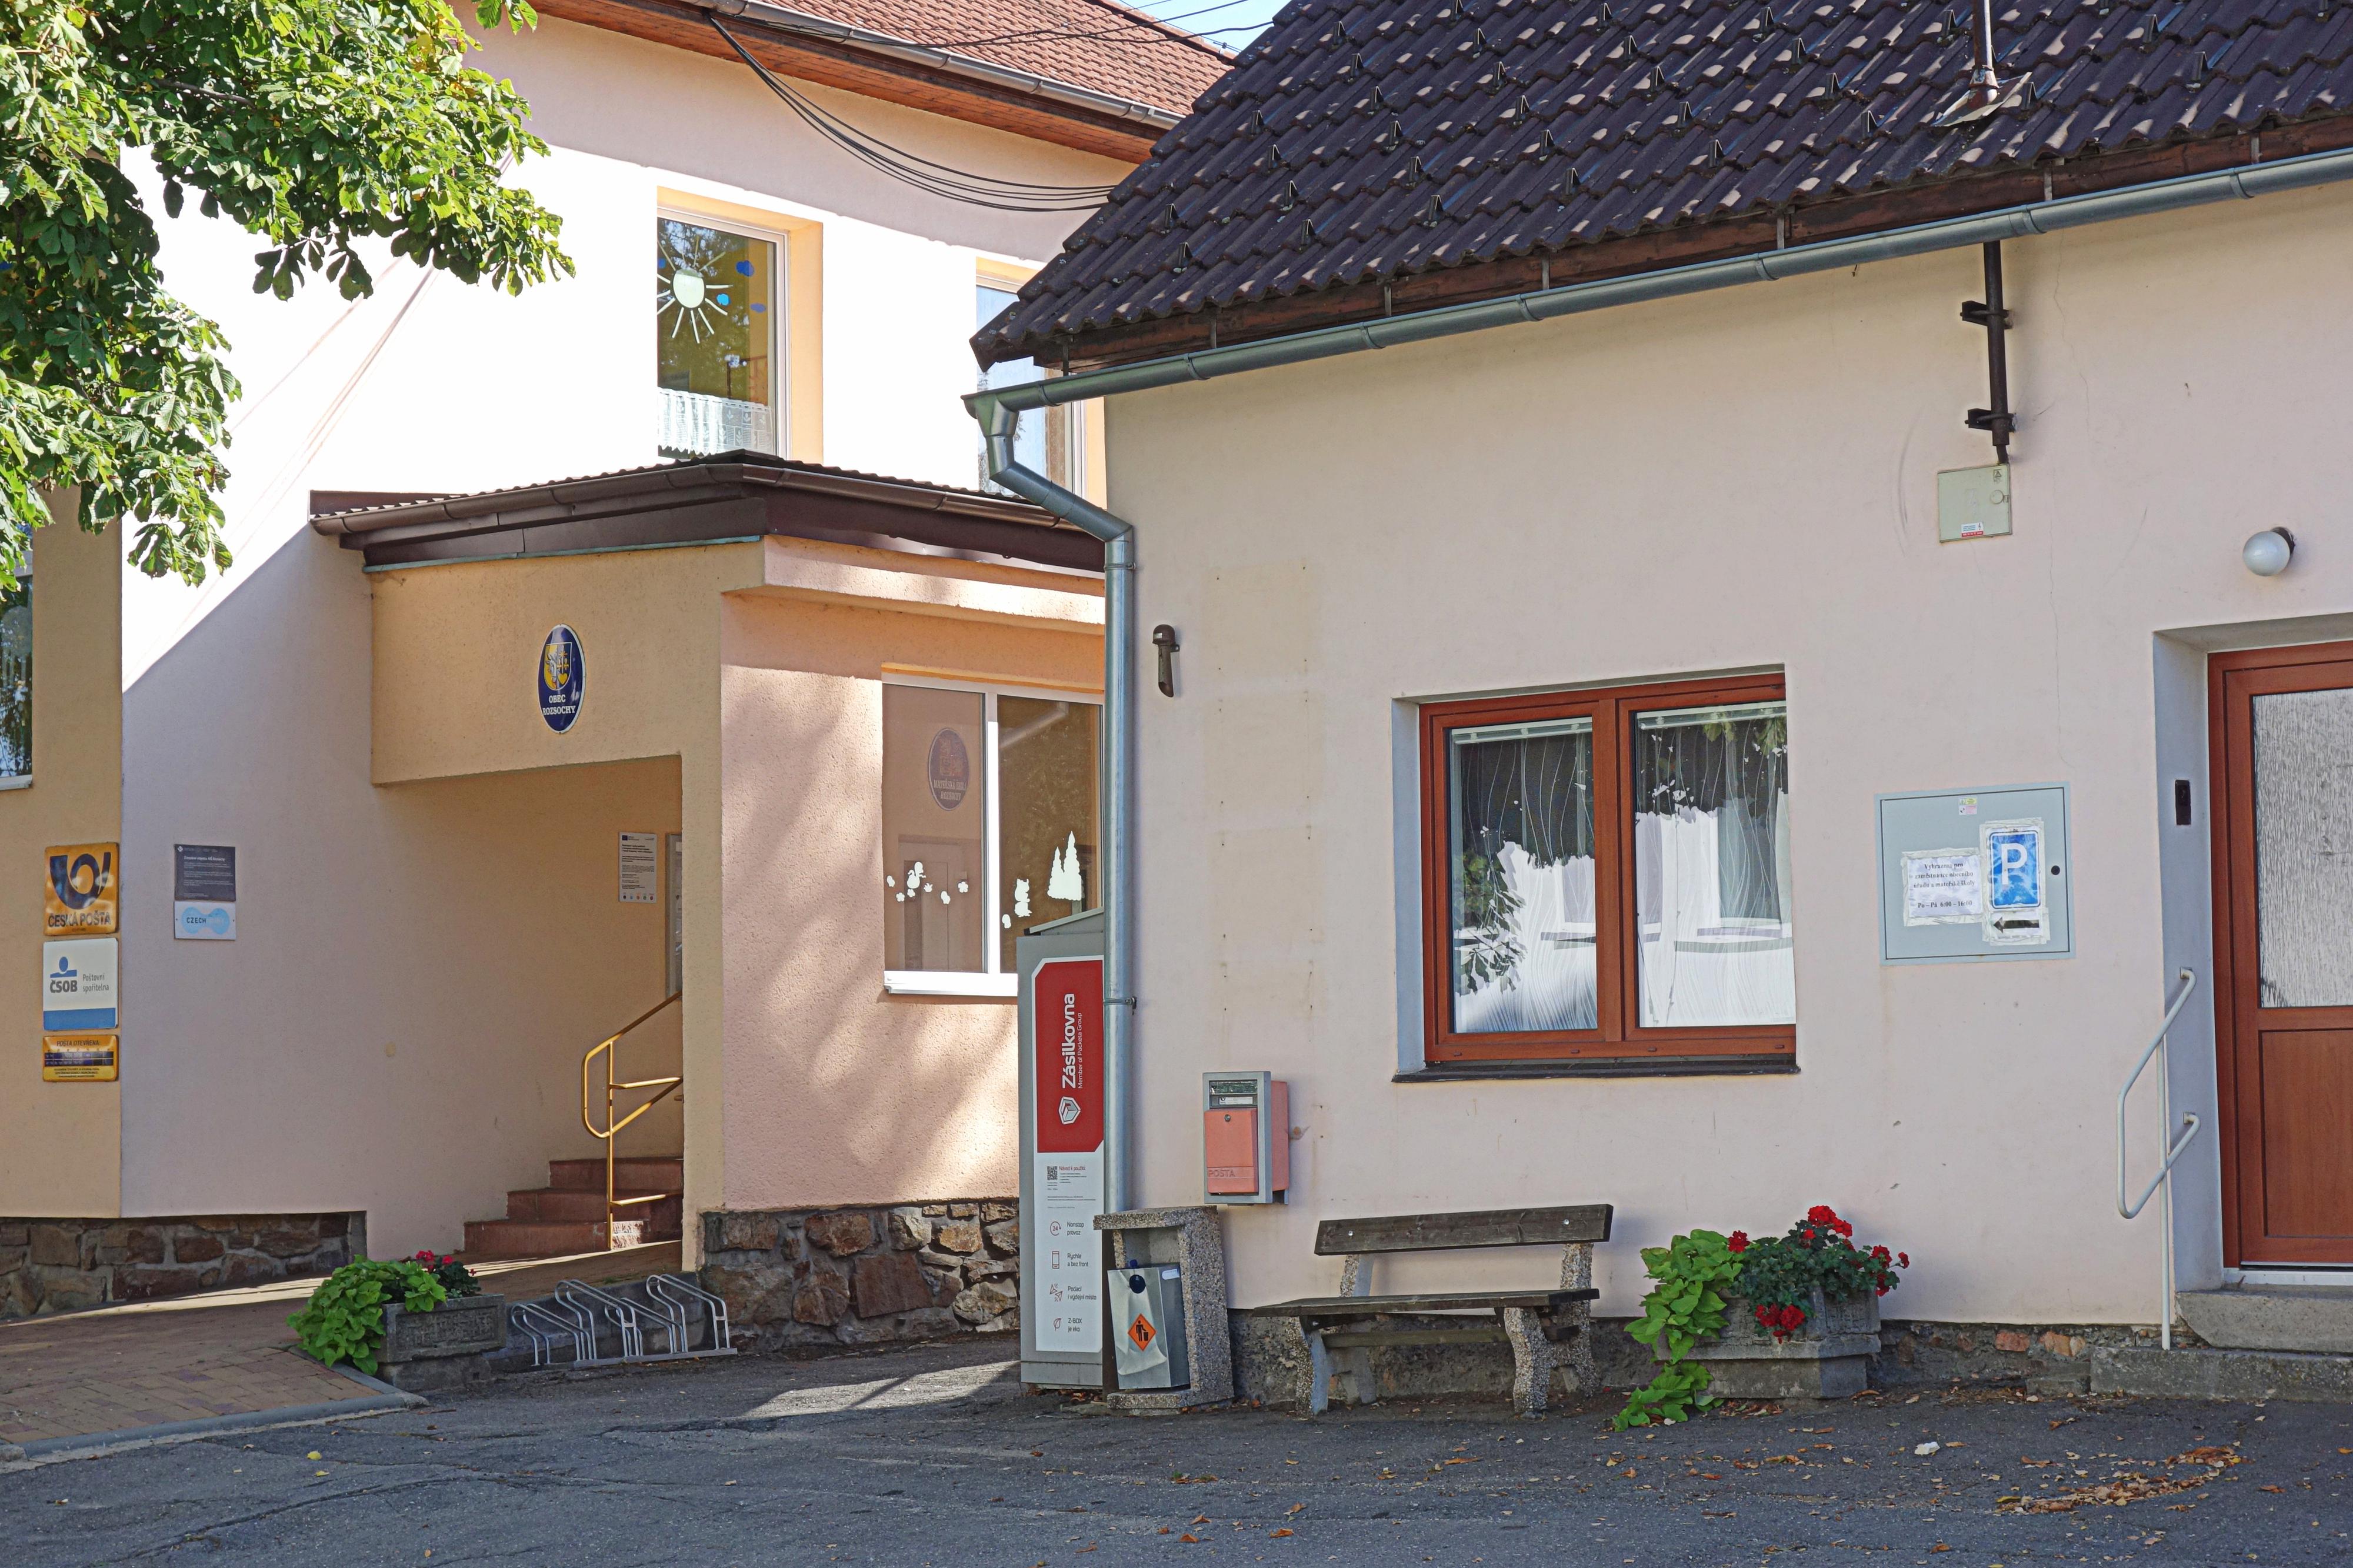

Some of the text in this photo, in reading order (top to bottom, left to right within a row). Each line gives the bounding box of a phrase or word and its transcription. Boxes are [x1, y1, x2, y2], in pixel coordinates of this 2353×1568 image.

[549, 695, 565, 703] OBEC
[542, 706, 575, 715] ROZSOCHY
[2001, 843, 2028, 885] P
[48, 910, 111, 928] ČESKÁ POŠTA
[83, 973, 105, 982] Poštovní
[49, 979, 78, 993] ČSOB
[83, 984, 109, 994] spořitelna
[1061, 993, 1076, 1089] Zásilkovna
[1208, 1168, 1236, 1177] POŠTA
